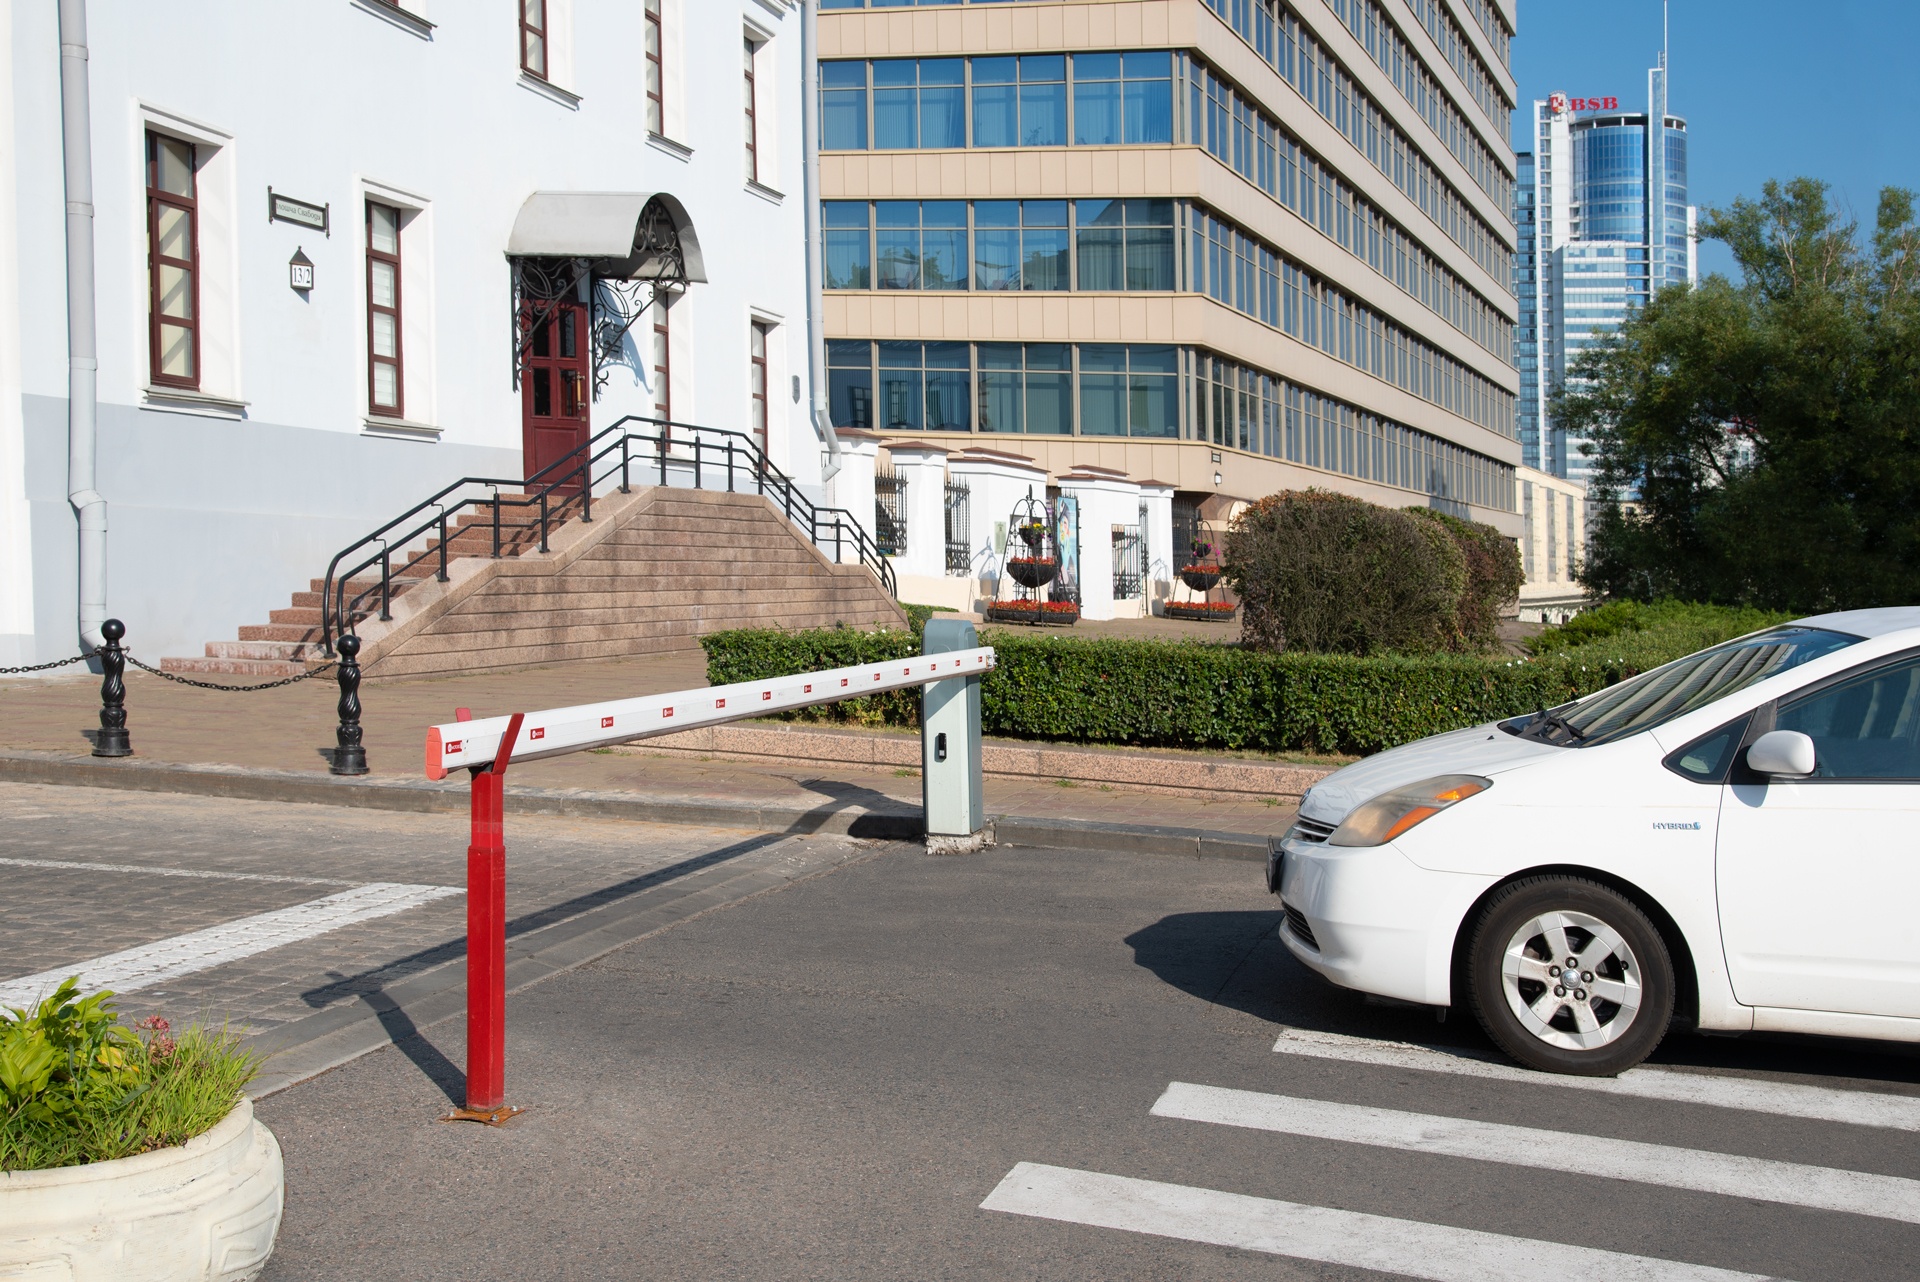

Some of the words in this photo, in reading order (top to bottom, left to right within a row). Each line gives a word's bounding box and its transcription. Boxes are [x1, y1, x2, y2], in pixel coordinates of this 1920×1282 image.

[1570, 96, 1618, 111] BSB
[294, 267, 310, 284] 13/2
[1653, 822, 1692, 830] HYBRID
